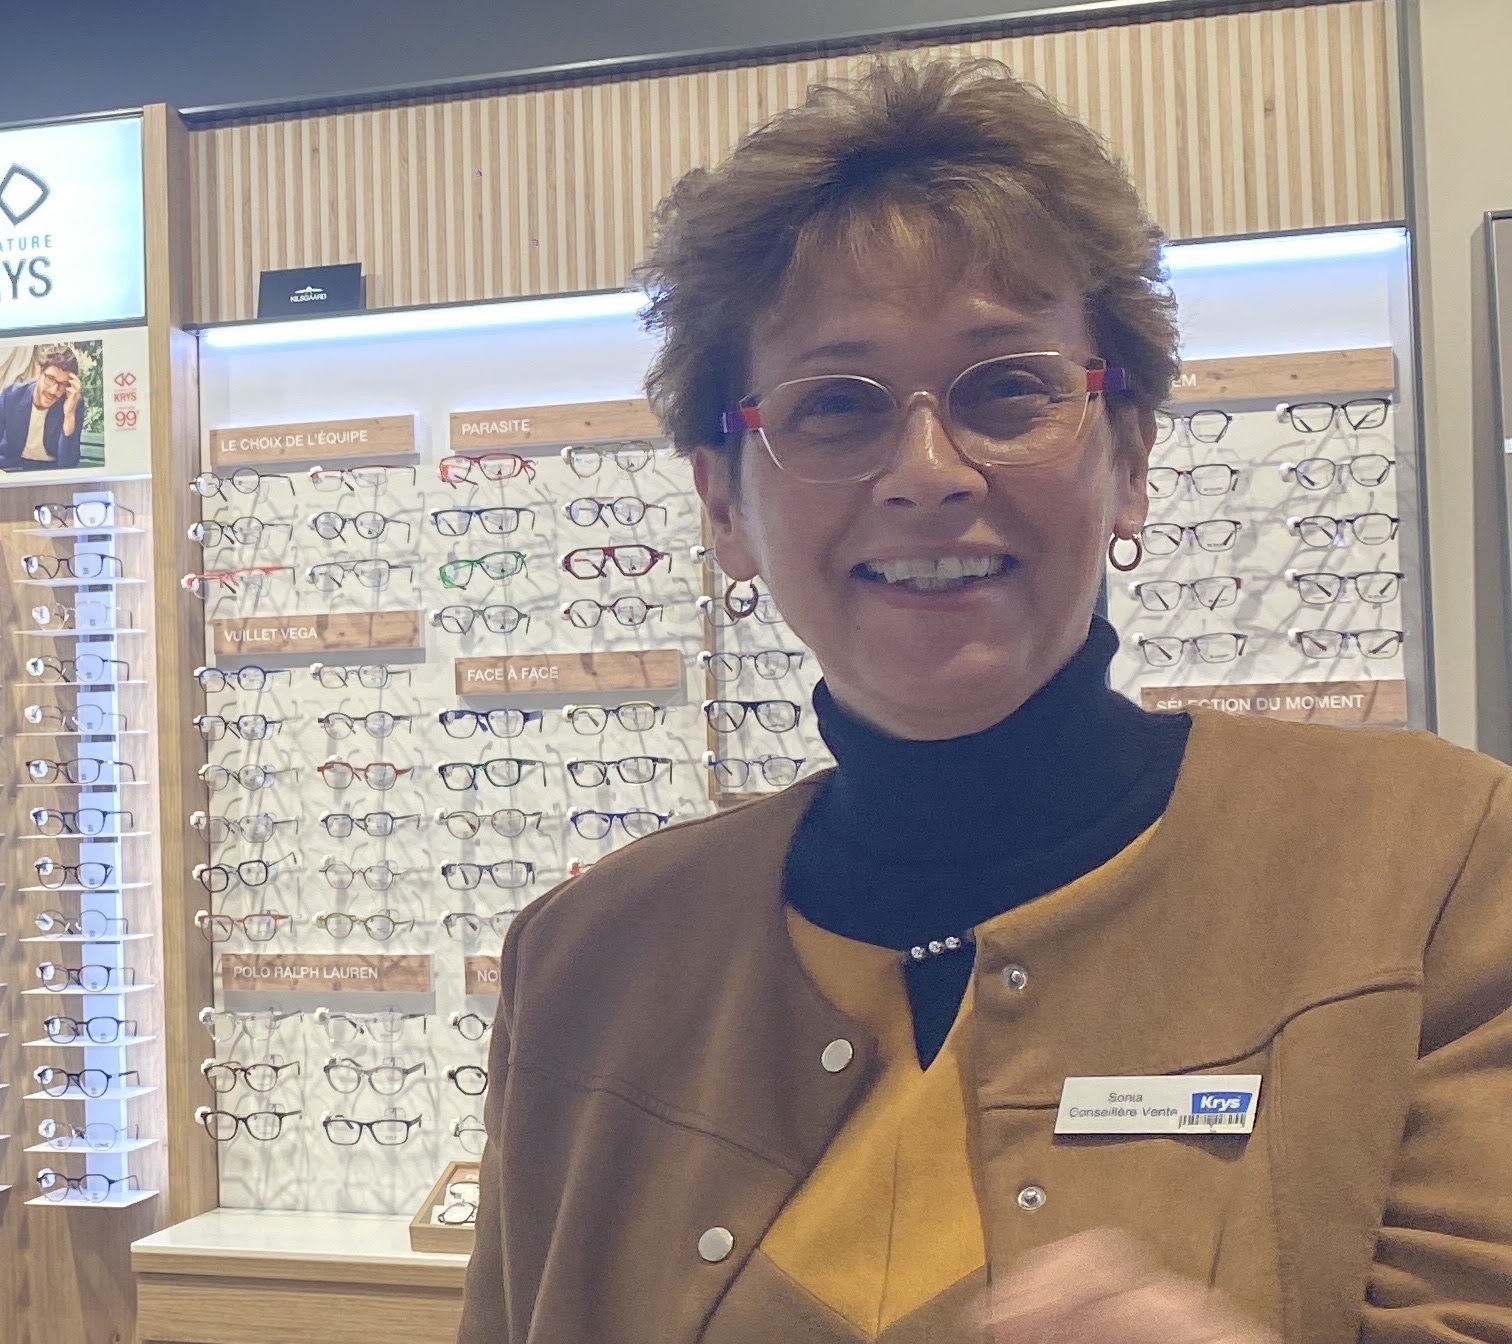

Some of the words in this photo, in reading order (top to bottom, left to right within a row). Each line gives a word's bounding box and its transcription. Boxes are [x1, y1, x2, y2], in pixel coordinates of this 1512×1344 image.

[114, 392, 137, 402] KRYS
[461, 419, 530, 435] PARASITE
[221, 439, 238, 453] LE
[240, 436, 282, 451] CHOIX
[285, 434, 304, 448] DE
[308, 429, 368, 446] L'ÉQUIPE
[224, 627, 277, 642] VUILLET
[280, 626, 318, 640] VEGA
[467, 668, 503, 682] FACE
[507, 664, 518, 680] À
[521, 666, 558, 680] FACE
[1256, 697, 1280, 711] DU
[1286, 694, 1364, 710] MOMENT
[233, 967, 271, 979] POLO
[274, 966, 319, 979] RALPH
[323, 966, 378, 980] LAUREN
[477, 969, 501, 982] NO
[1108, 1092, 1143, 1104] Sonia
[1200, 1095, 1241, 1112] Krys
[1069, 1107, 1138, 1118] Conseillère
[1142, 1107, 1178, 1117] Vente
